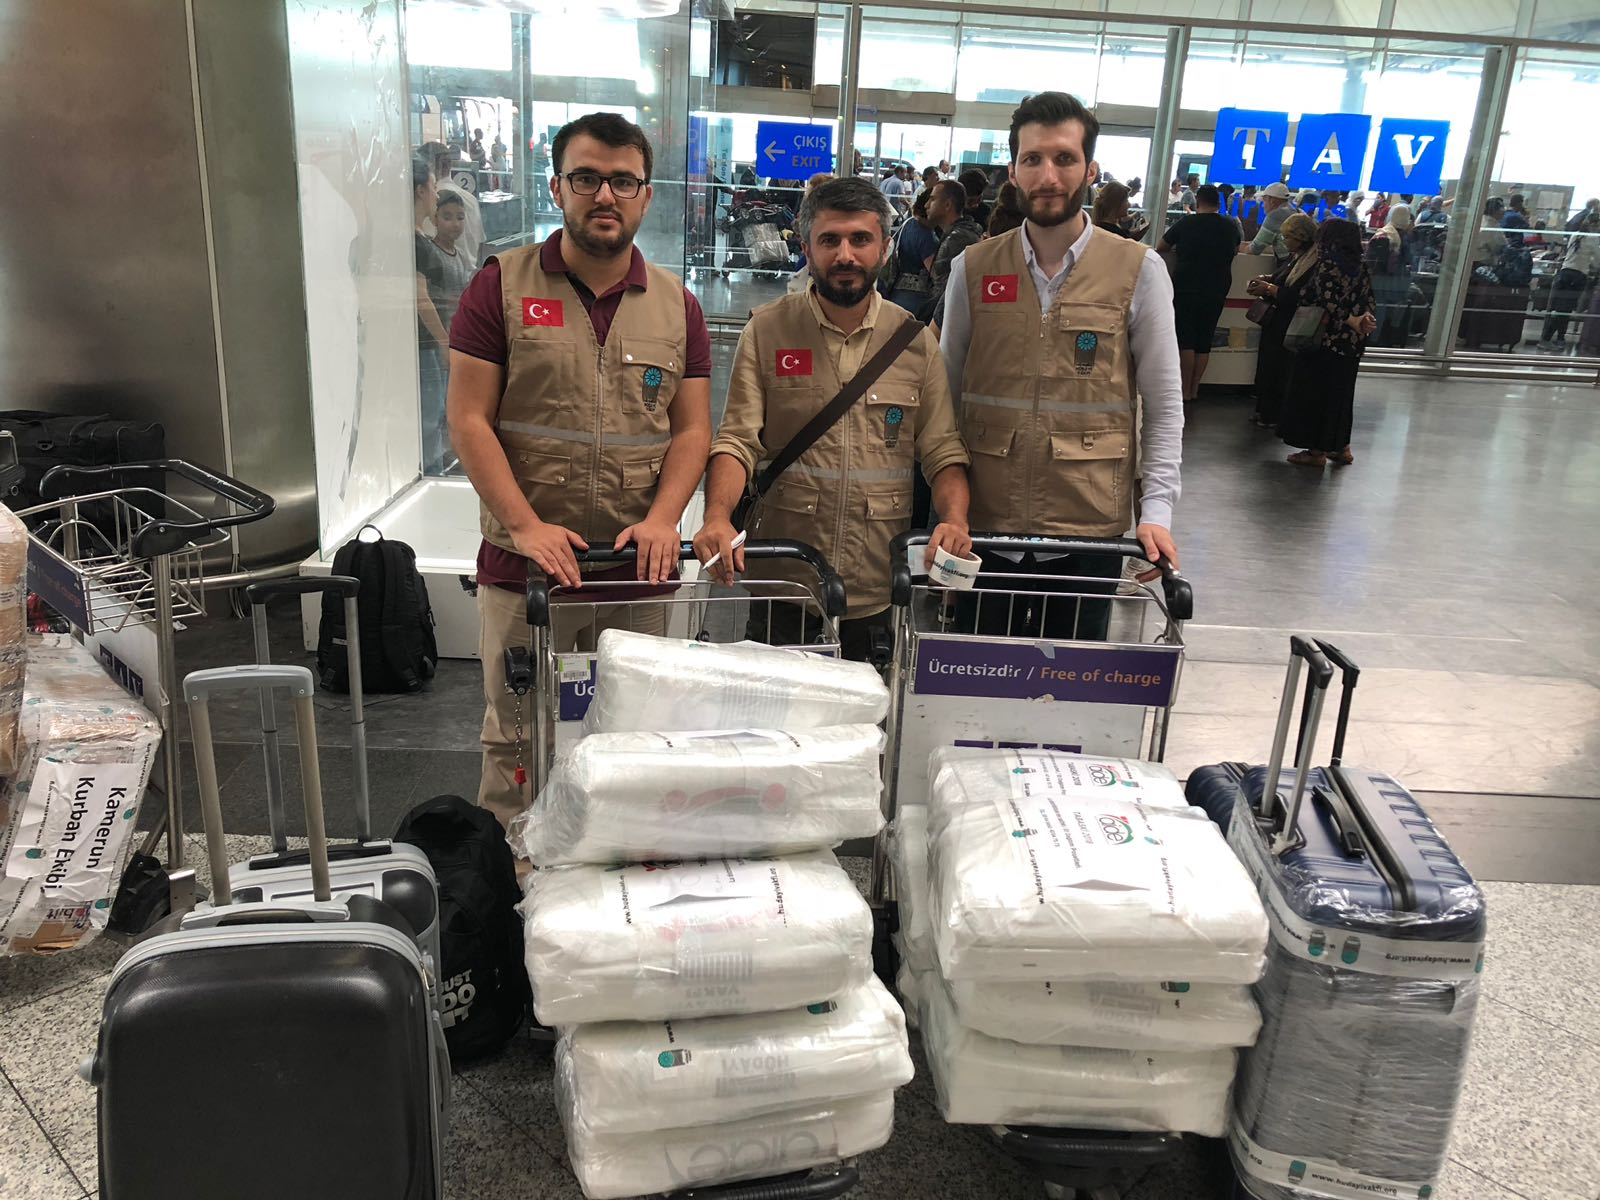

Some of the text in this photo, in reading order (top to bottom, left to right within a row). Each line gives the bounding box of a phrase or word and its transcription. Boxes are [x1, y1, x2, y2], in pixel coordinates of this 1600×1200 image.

[793, 135, 827, 152] ÇIKIŞ
[1232, 127, 1435, 179] TAV
[791, 155, 821, 169] EXIT
[460, 177, 469, 190] 2
[929, 658, 1161, 687] Ücretsizdir / Free of charge
[45, 777, 96, 889] Kurban Ekibi
[86, 787, 127, 869] Kamerun
[441, 983, 476, 1011] DO
